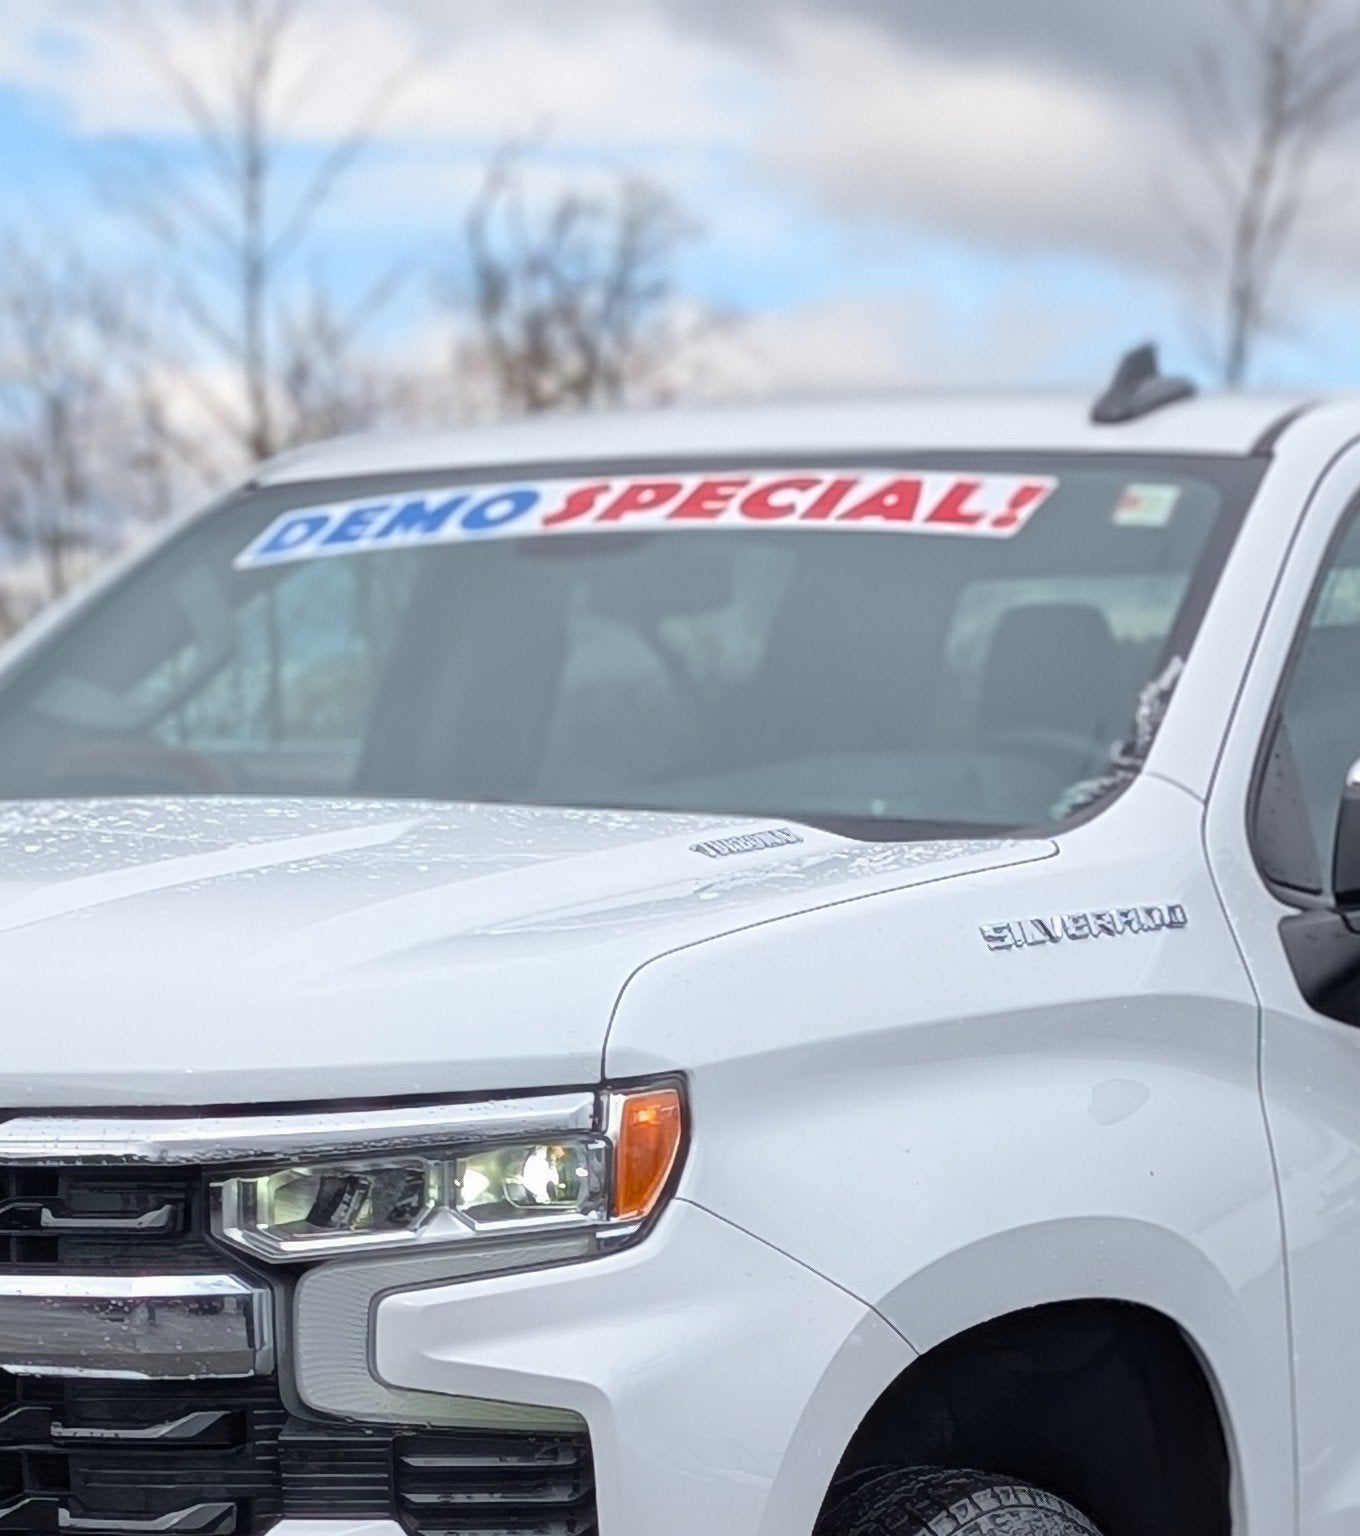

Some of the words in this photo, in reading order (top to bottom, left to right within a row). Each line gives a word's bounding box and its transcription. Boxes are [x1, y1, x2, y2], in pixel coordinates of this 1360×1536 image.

[258, 489, 541, 555] DEMO
[541, 477, 1052, 529] SPECIAL!
[978, 904, 1188, 951] SILVERADO
